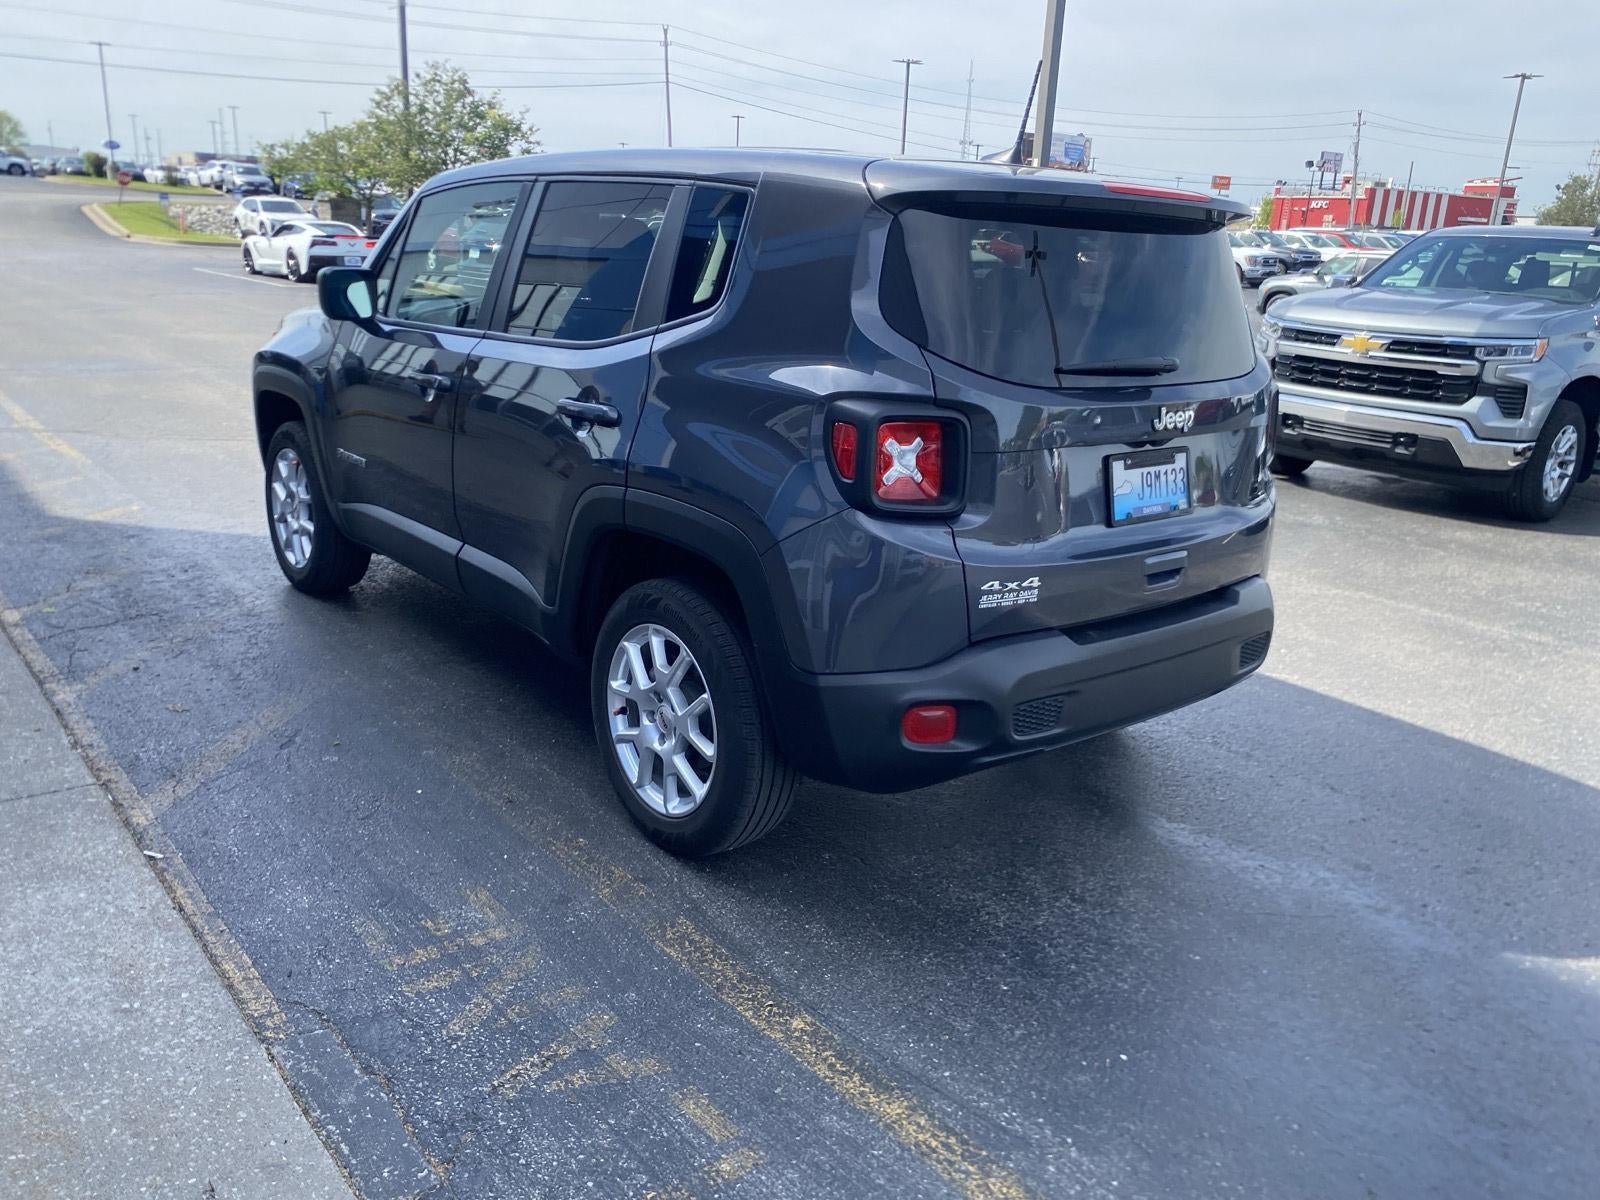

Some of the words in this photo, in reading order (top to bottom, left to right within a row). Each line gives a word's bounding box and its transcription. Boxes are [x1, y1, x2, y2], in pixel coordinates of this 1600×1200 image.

[1310, 200, 1330, 209] KFC
[1153, 406, 1195, 433] Jeep
[1137, 466, 1187, 501] J9M133
[980, 576, 1042, 591] 4x4
